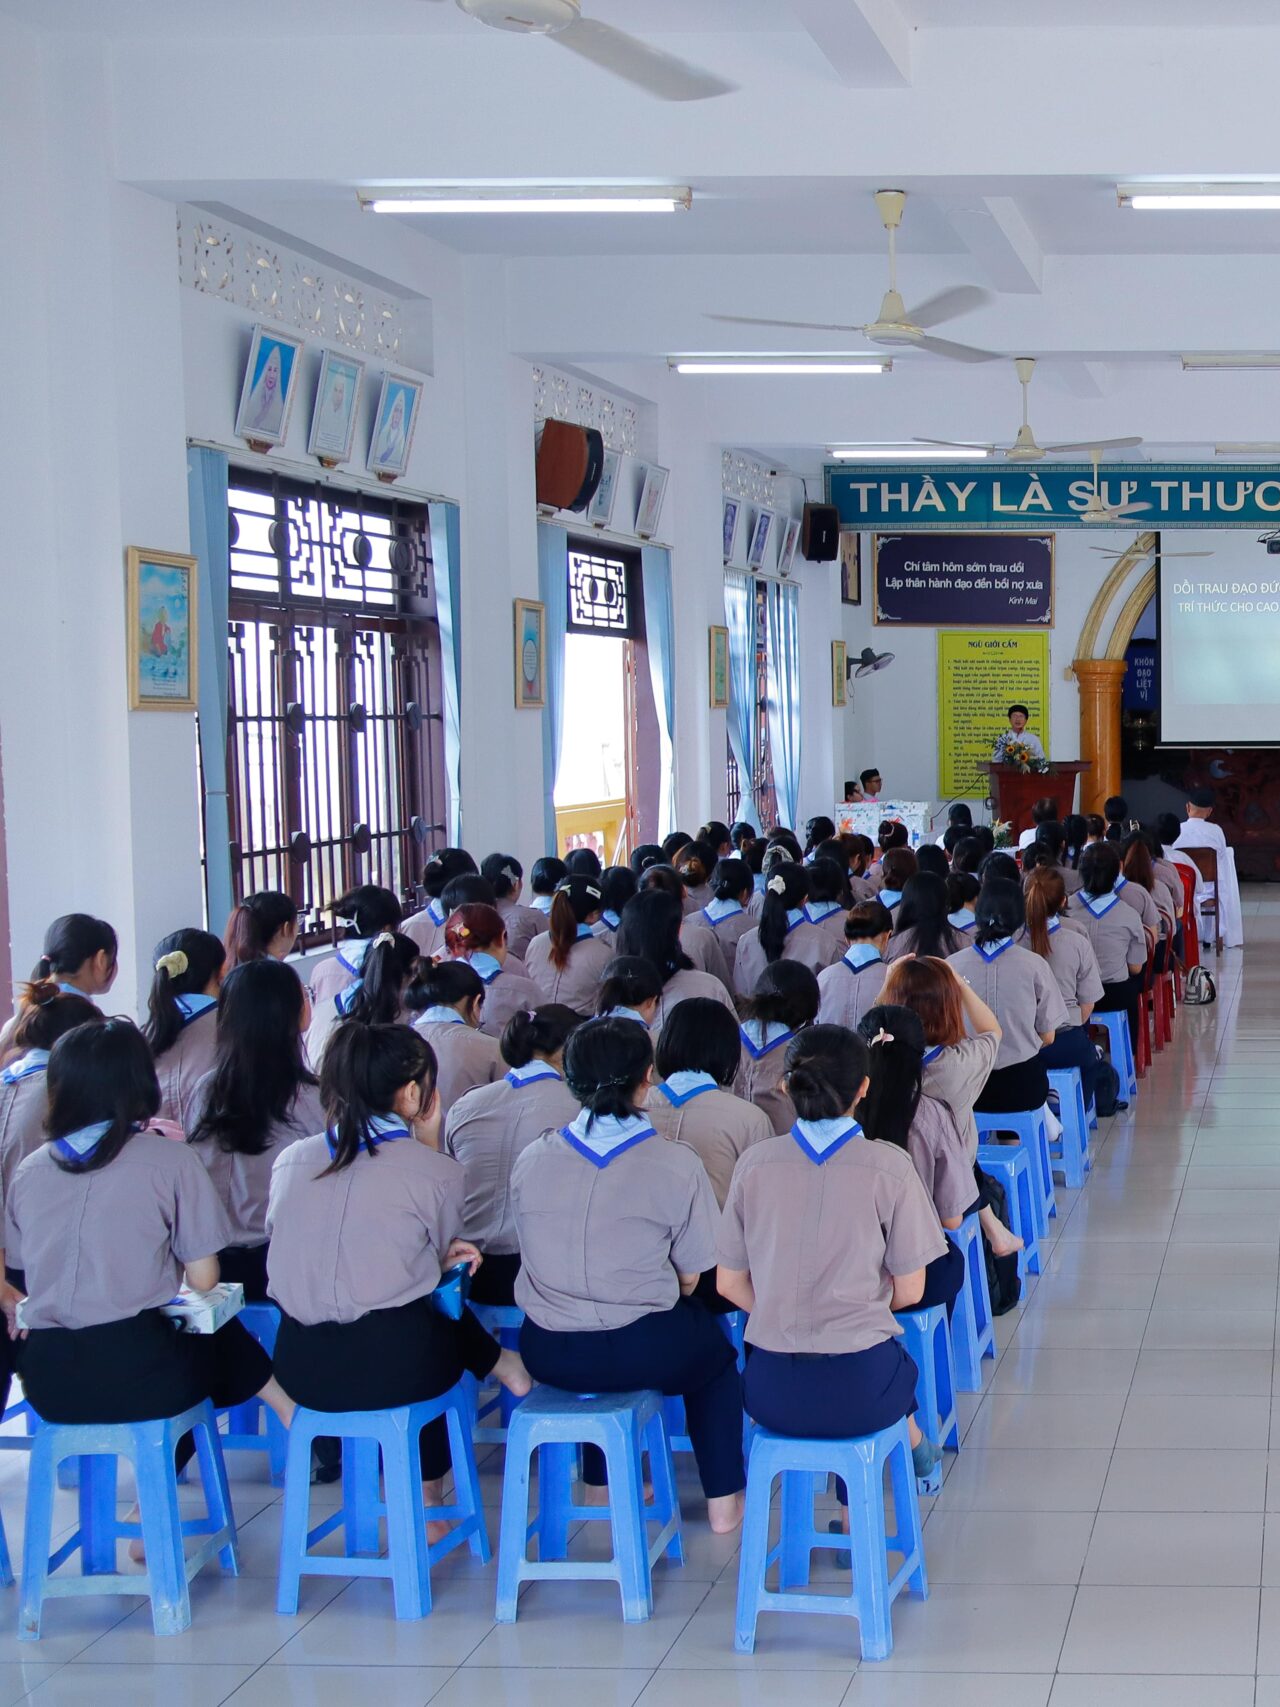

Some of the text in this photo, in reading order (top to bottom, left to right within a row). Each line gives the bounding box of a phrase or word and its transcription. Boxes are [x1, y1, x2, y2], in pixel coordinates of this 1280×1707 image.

[850, 474, 977, 512] THẦY
[992, 473, 1053, 511] LÀ
[1067, 480, 1138, 511] SƯ
[904, 561, 920, 572] Chí
[922, 562, 940, 572] tâm
[942, 562, 964, 572] hôm
[966, 562, 987, 572] sớm
[989, 563, 1007, 573] trau
[885, 577, 903, 590] Lập
[905, 577, 926, 588] thân
[928, 577, 952, 588] hành
[954, 579, 972, 590] đạo
[1011, 580, 1025, 591] nợ
[1026, 580, 1043, 589] xưa
[1173, 579, 1194, 594] DỒI
[1197, 583, 1228, 594] TRAU
[1231, 582, 1258, 596] ĐẠO
[1177, 600, 1279, 612] TRÍ THỨC CHO CAO
